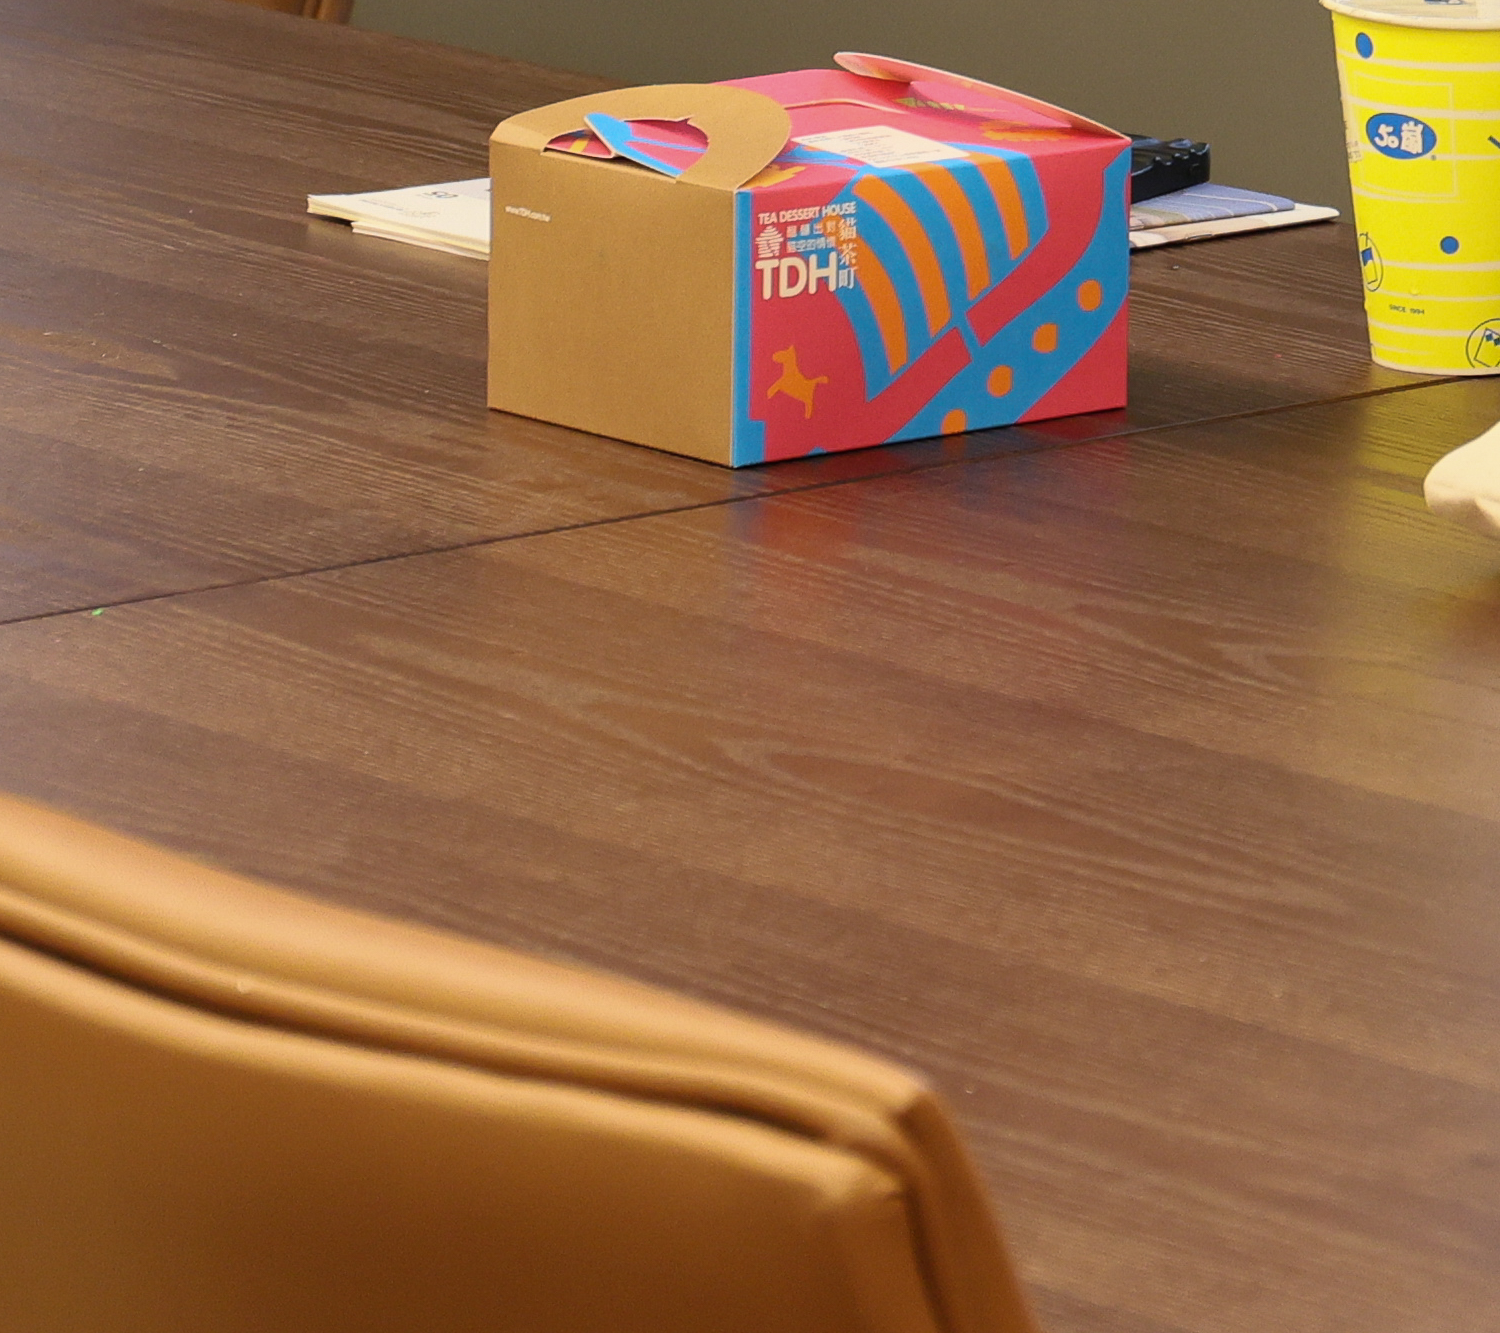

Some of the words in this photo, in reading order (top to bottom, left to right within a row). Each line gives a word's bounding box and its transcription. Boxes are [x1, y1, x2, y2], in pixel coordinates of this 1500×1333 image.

[758, 212, 778, 225] TEA
[779, 206, 820, 223] DESSERT
[822, 201, 856, 217] HOUSE
[755, 251, 838, 300] TDH
